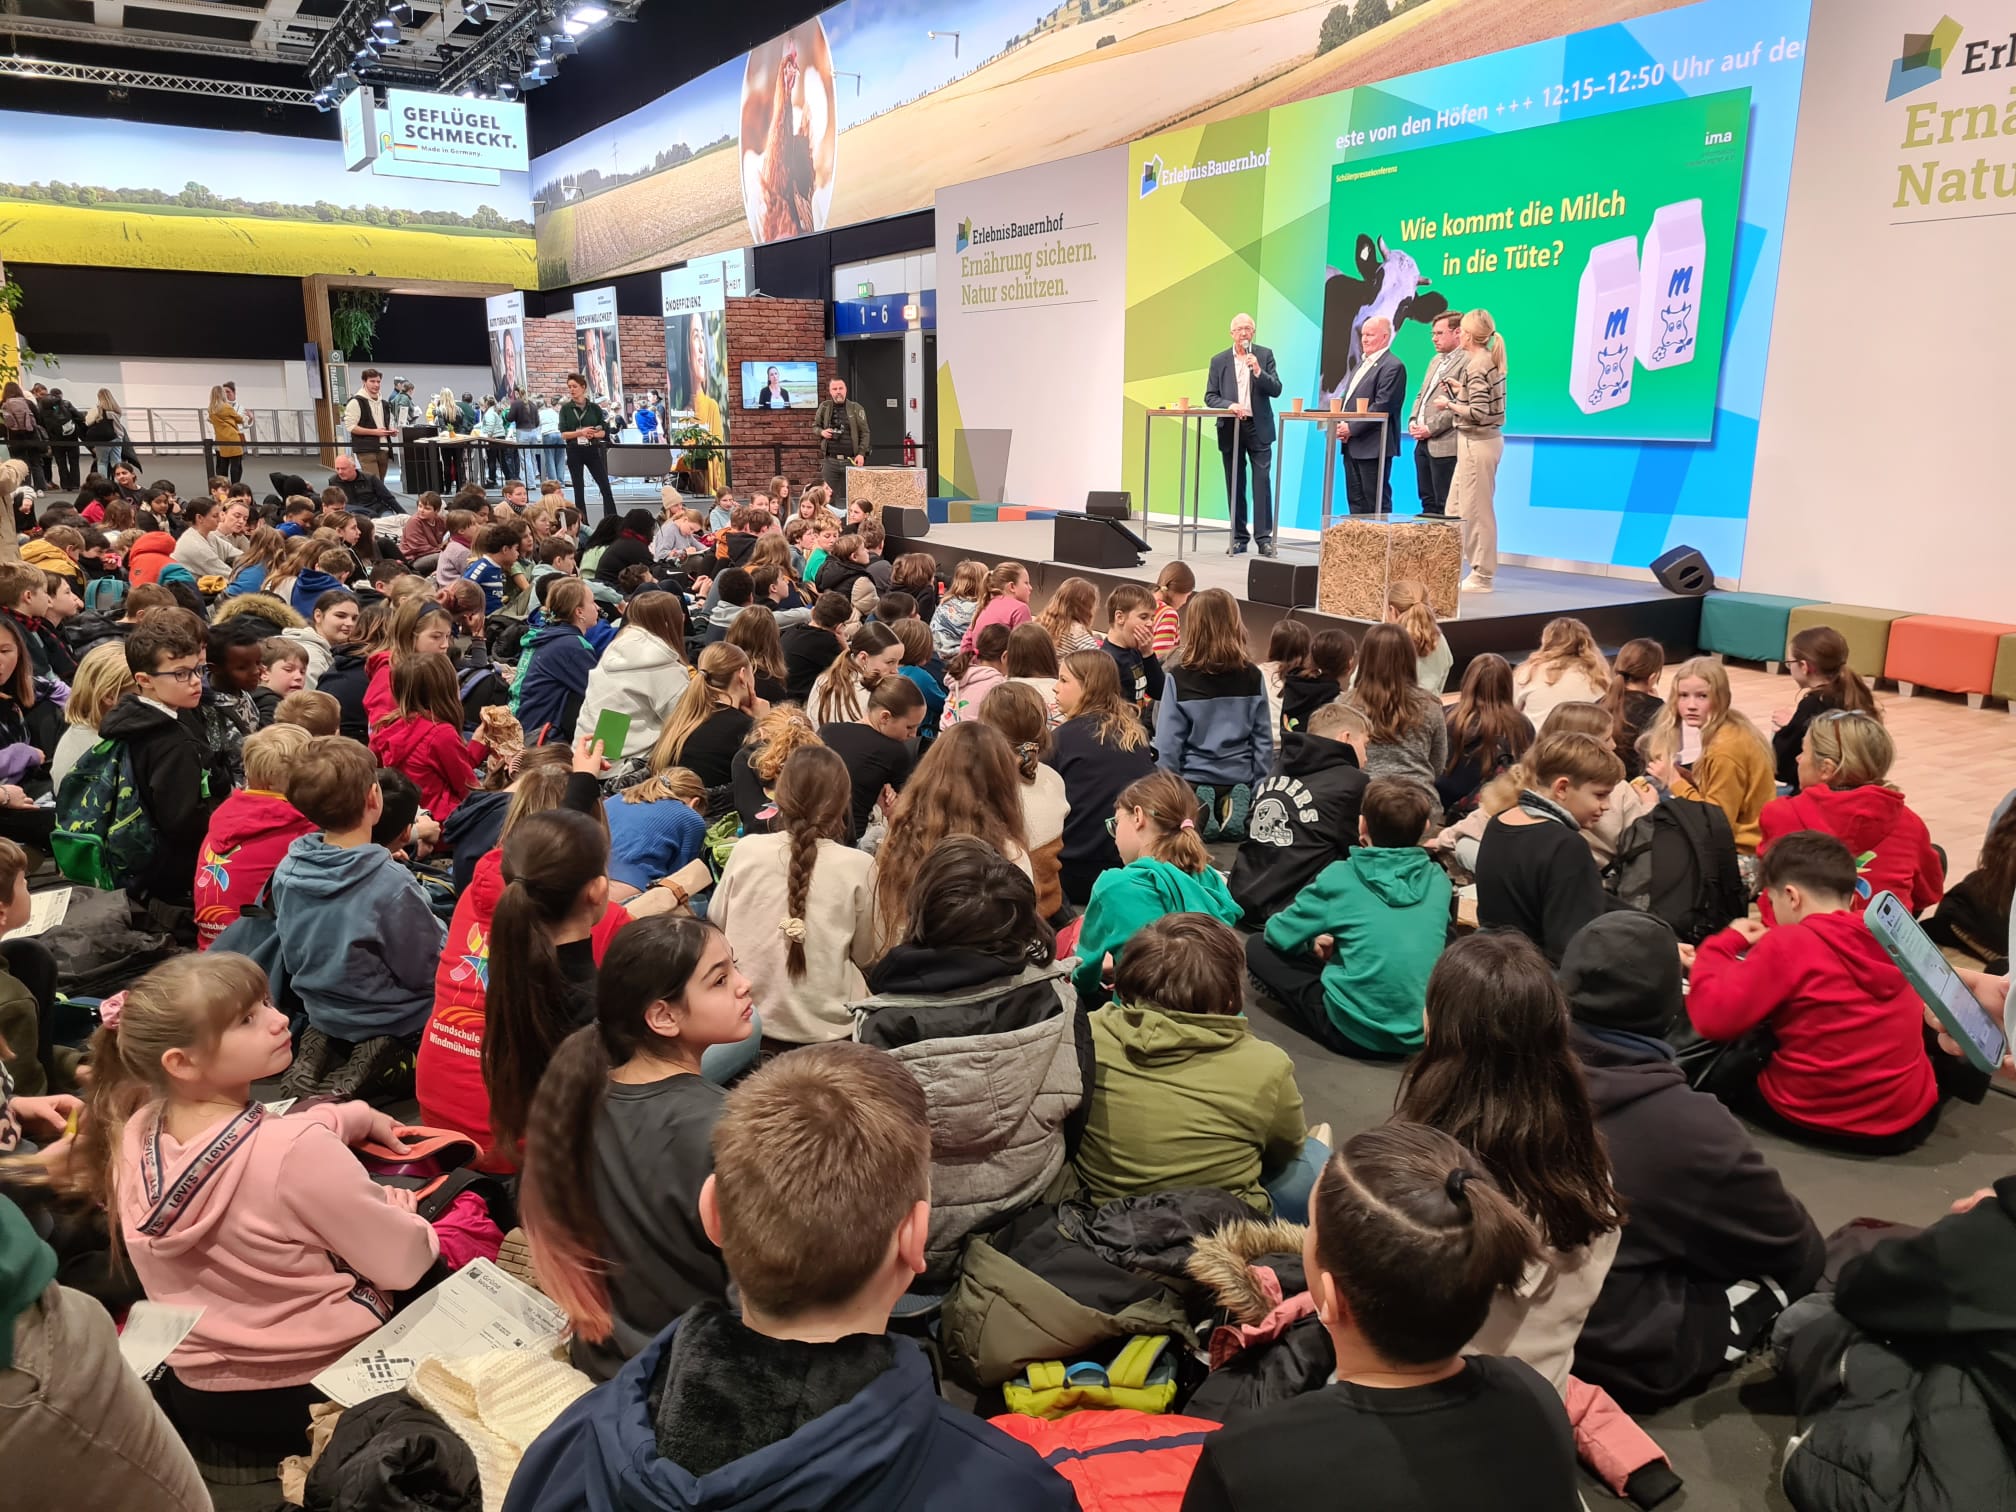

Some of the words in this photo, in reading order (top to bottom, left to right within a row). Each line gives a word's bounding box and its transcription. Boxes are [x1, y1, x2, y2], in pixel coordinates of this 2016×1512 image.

[1369, 123, 1397, 143] von
[1401, 115, 1431, 137] den
[1436, 103, 1488, 129] Höfen
[1671, 56, 1714, 82] Uhr
[1720, 40, 1763, 73] auf
[1768, 36, 1807, 63] de
[403, 106, 501, 131] GEFLÜGEL
[405, 124, 517, 149] SCHMECKT.
[421, 145, 441, 153] Made
[1161, 146, 1271, 186] ErlebnisBauernhof
[972, 212, 1064, 245] ErlebnisBauernhof
[1400, 215, 1437, 242] Wie
[1442, 207, 1514, 237] kommt
[1519, 200, 1553, 228] die
[1560, 189, 1626, 223] Milch
[961, 250, 1033, 278] Ernährung
[1036, 240, 1097, 268] sichern.
[1442, 252, 1461, 276] in
[1466, 248, 1498, 273] die
[1503, 239, 1564, 271] Tüte?
[665, 296, 702, 312] ÖKOEFFIZIENZ
[961, 284, 998, 306] Natur
[1000, 275, 1069, 302] schützen.
[432, 1018, 480, 1043] Grundschule
